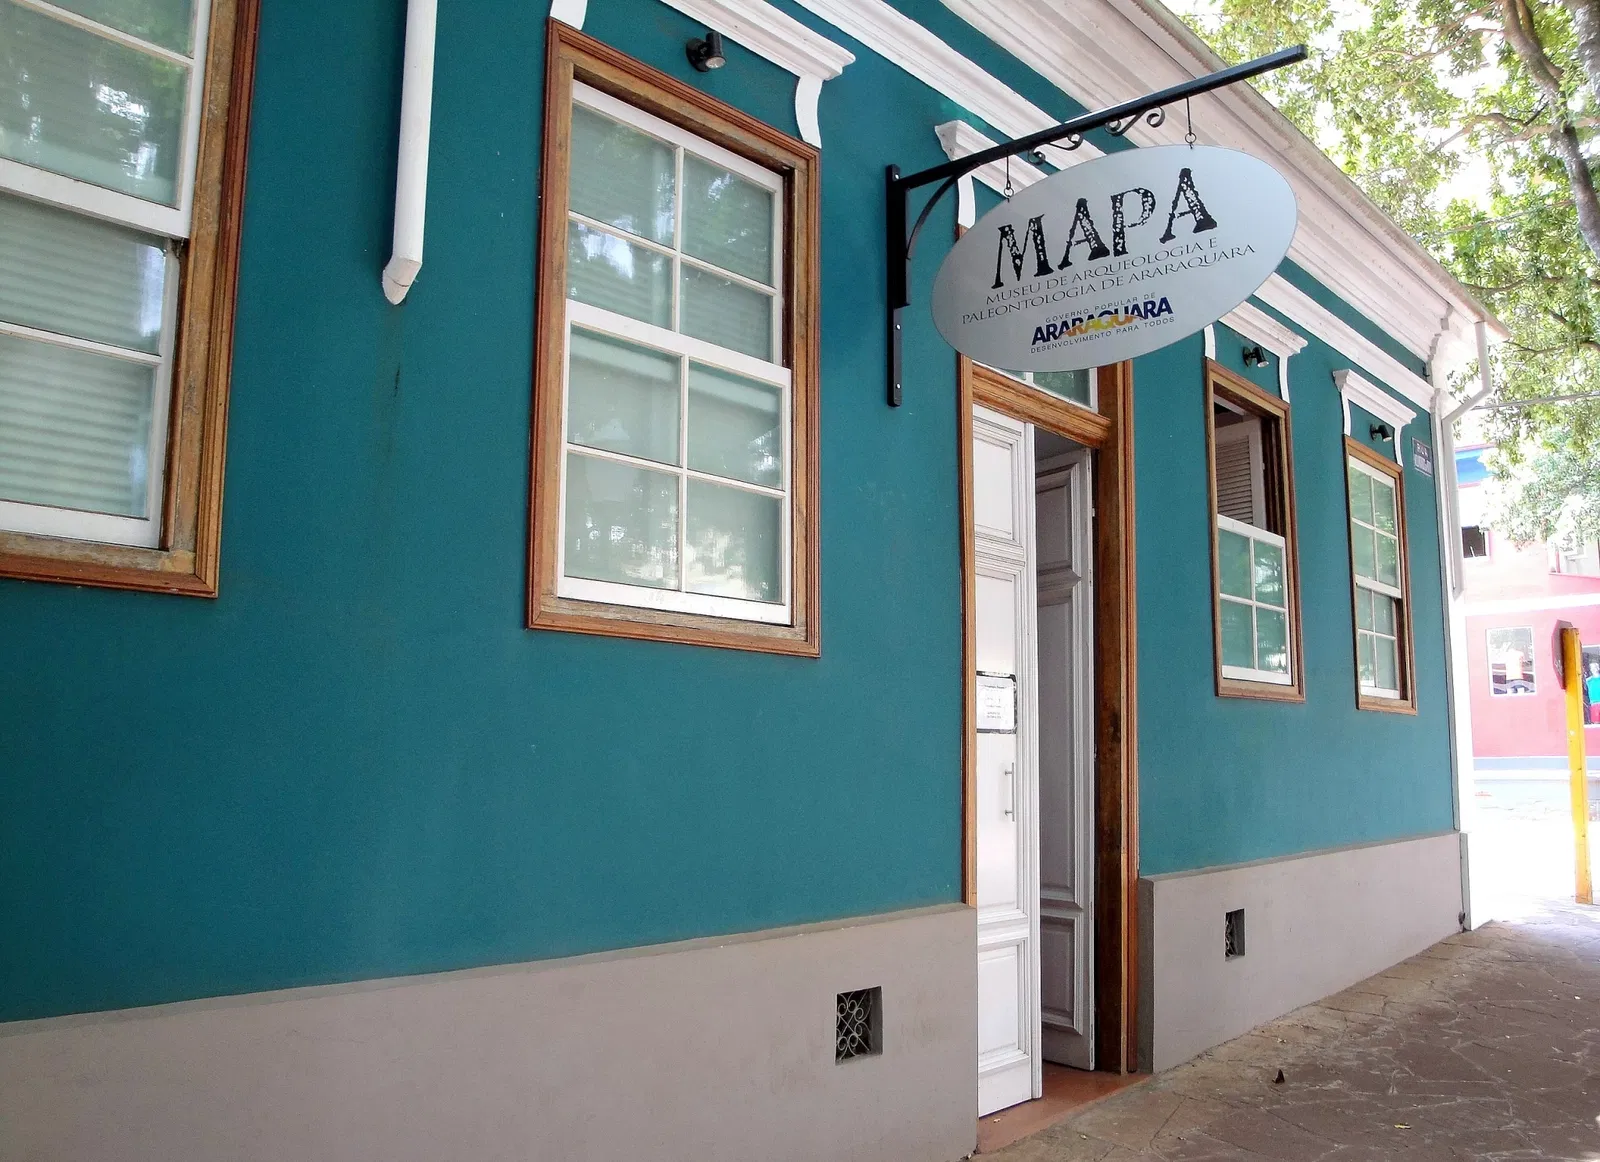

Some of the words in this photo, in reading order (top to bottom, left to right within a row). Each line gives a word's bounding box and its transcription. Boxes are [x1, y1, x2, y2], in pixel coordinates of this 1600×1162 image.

[991, 168, 1217, 289] MAPA
[962, 283, 1096, 324] PALEONTOLOGIA
[1101, 276, 1124, 290] DE
[1128, 244, 1255, 283] ARARAQUARA
[986, 282, 1041, 305] MUSEU
[1046, 275, 1068, 290] DE
[1072, 241, 1204, 281] ARQUEOLOGIA
[1209, 237, 1218, 248] E
[1030, 330, 1112, 354] DESENVOLVIMENTO
[1116, 324, 1140, 335] PARA
[1144, 316, 1175, 329] TODOS
[1031, 297, 1174, 346] ARARAQUARA
[1045, 308, 1089, 323] GOVERNO
[1094, 297, 1138, 312] POPULAR
[1144, 292, 1156, 300] DE
